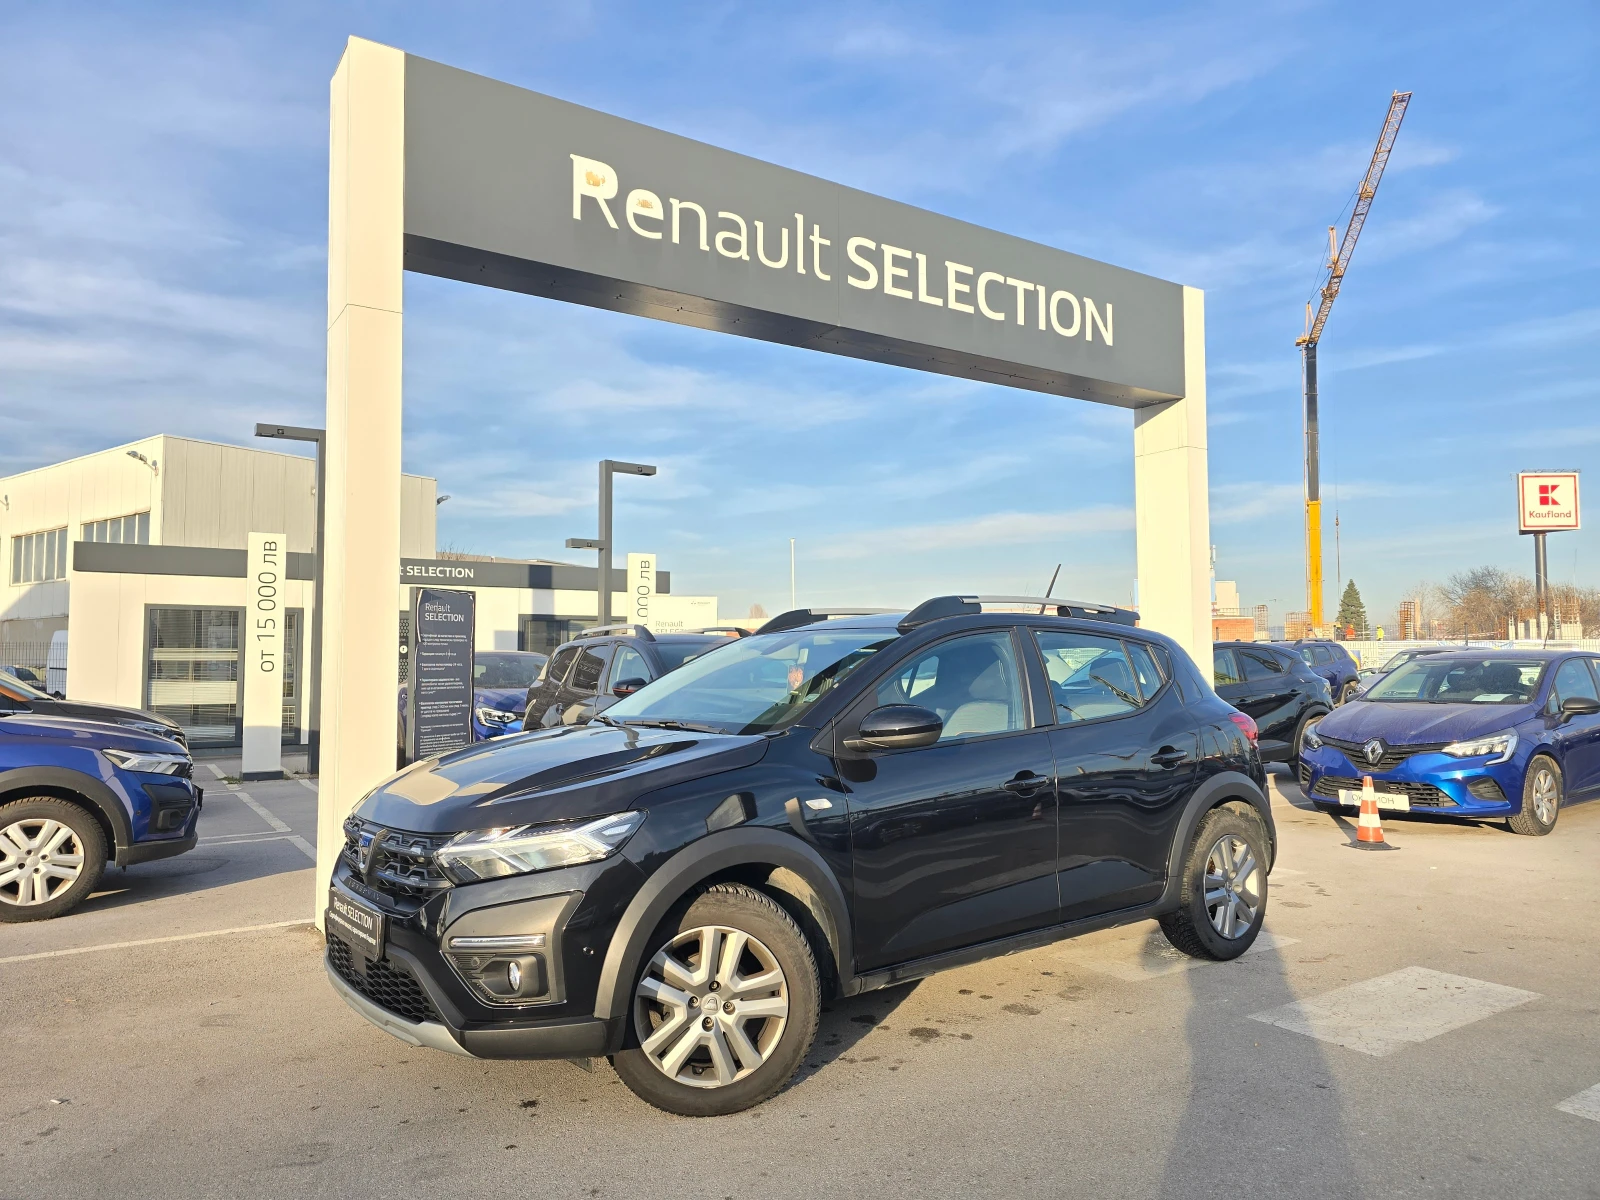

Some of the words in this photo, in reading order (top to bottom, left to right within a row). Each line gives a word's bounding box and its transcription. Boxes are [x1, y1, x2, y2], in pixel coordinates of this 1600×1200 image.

[570, 153, 831, 282] Renault
[846, 236, 1114, 347] SELECTION
[1529, 510, 1572, 519] Kaufland
[263, 541, 278, 566] лв
[406, 565, 474, 578] SELECTION
[257, 572, 277, 611] 000
[424, 612, 465, 622] SELECTION
[425, 602, 450, 612] Renault
[257, 618, 276, 642] 15
[655, 620, 684, 628] Renault
[260, 650, 275, 673] от
[347, 905, 373, 931] SELECTION
